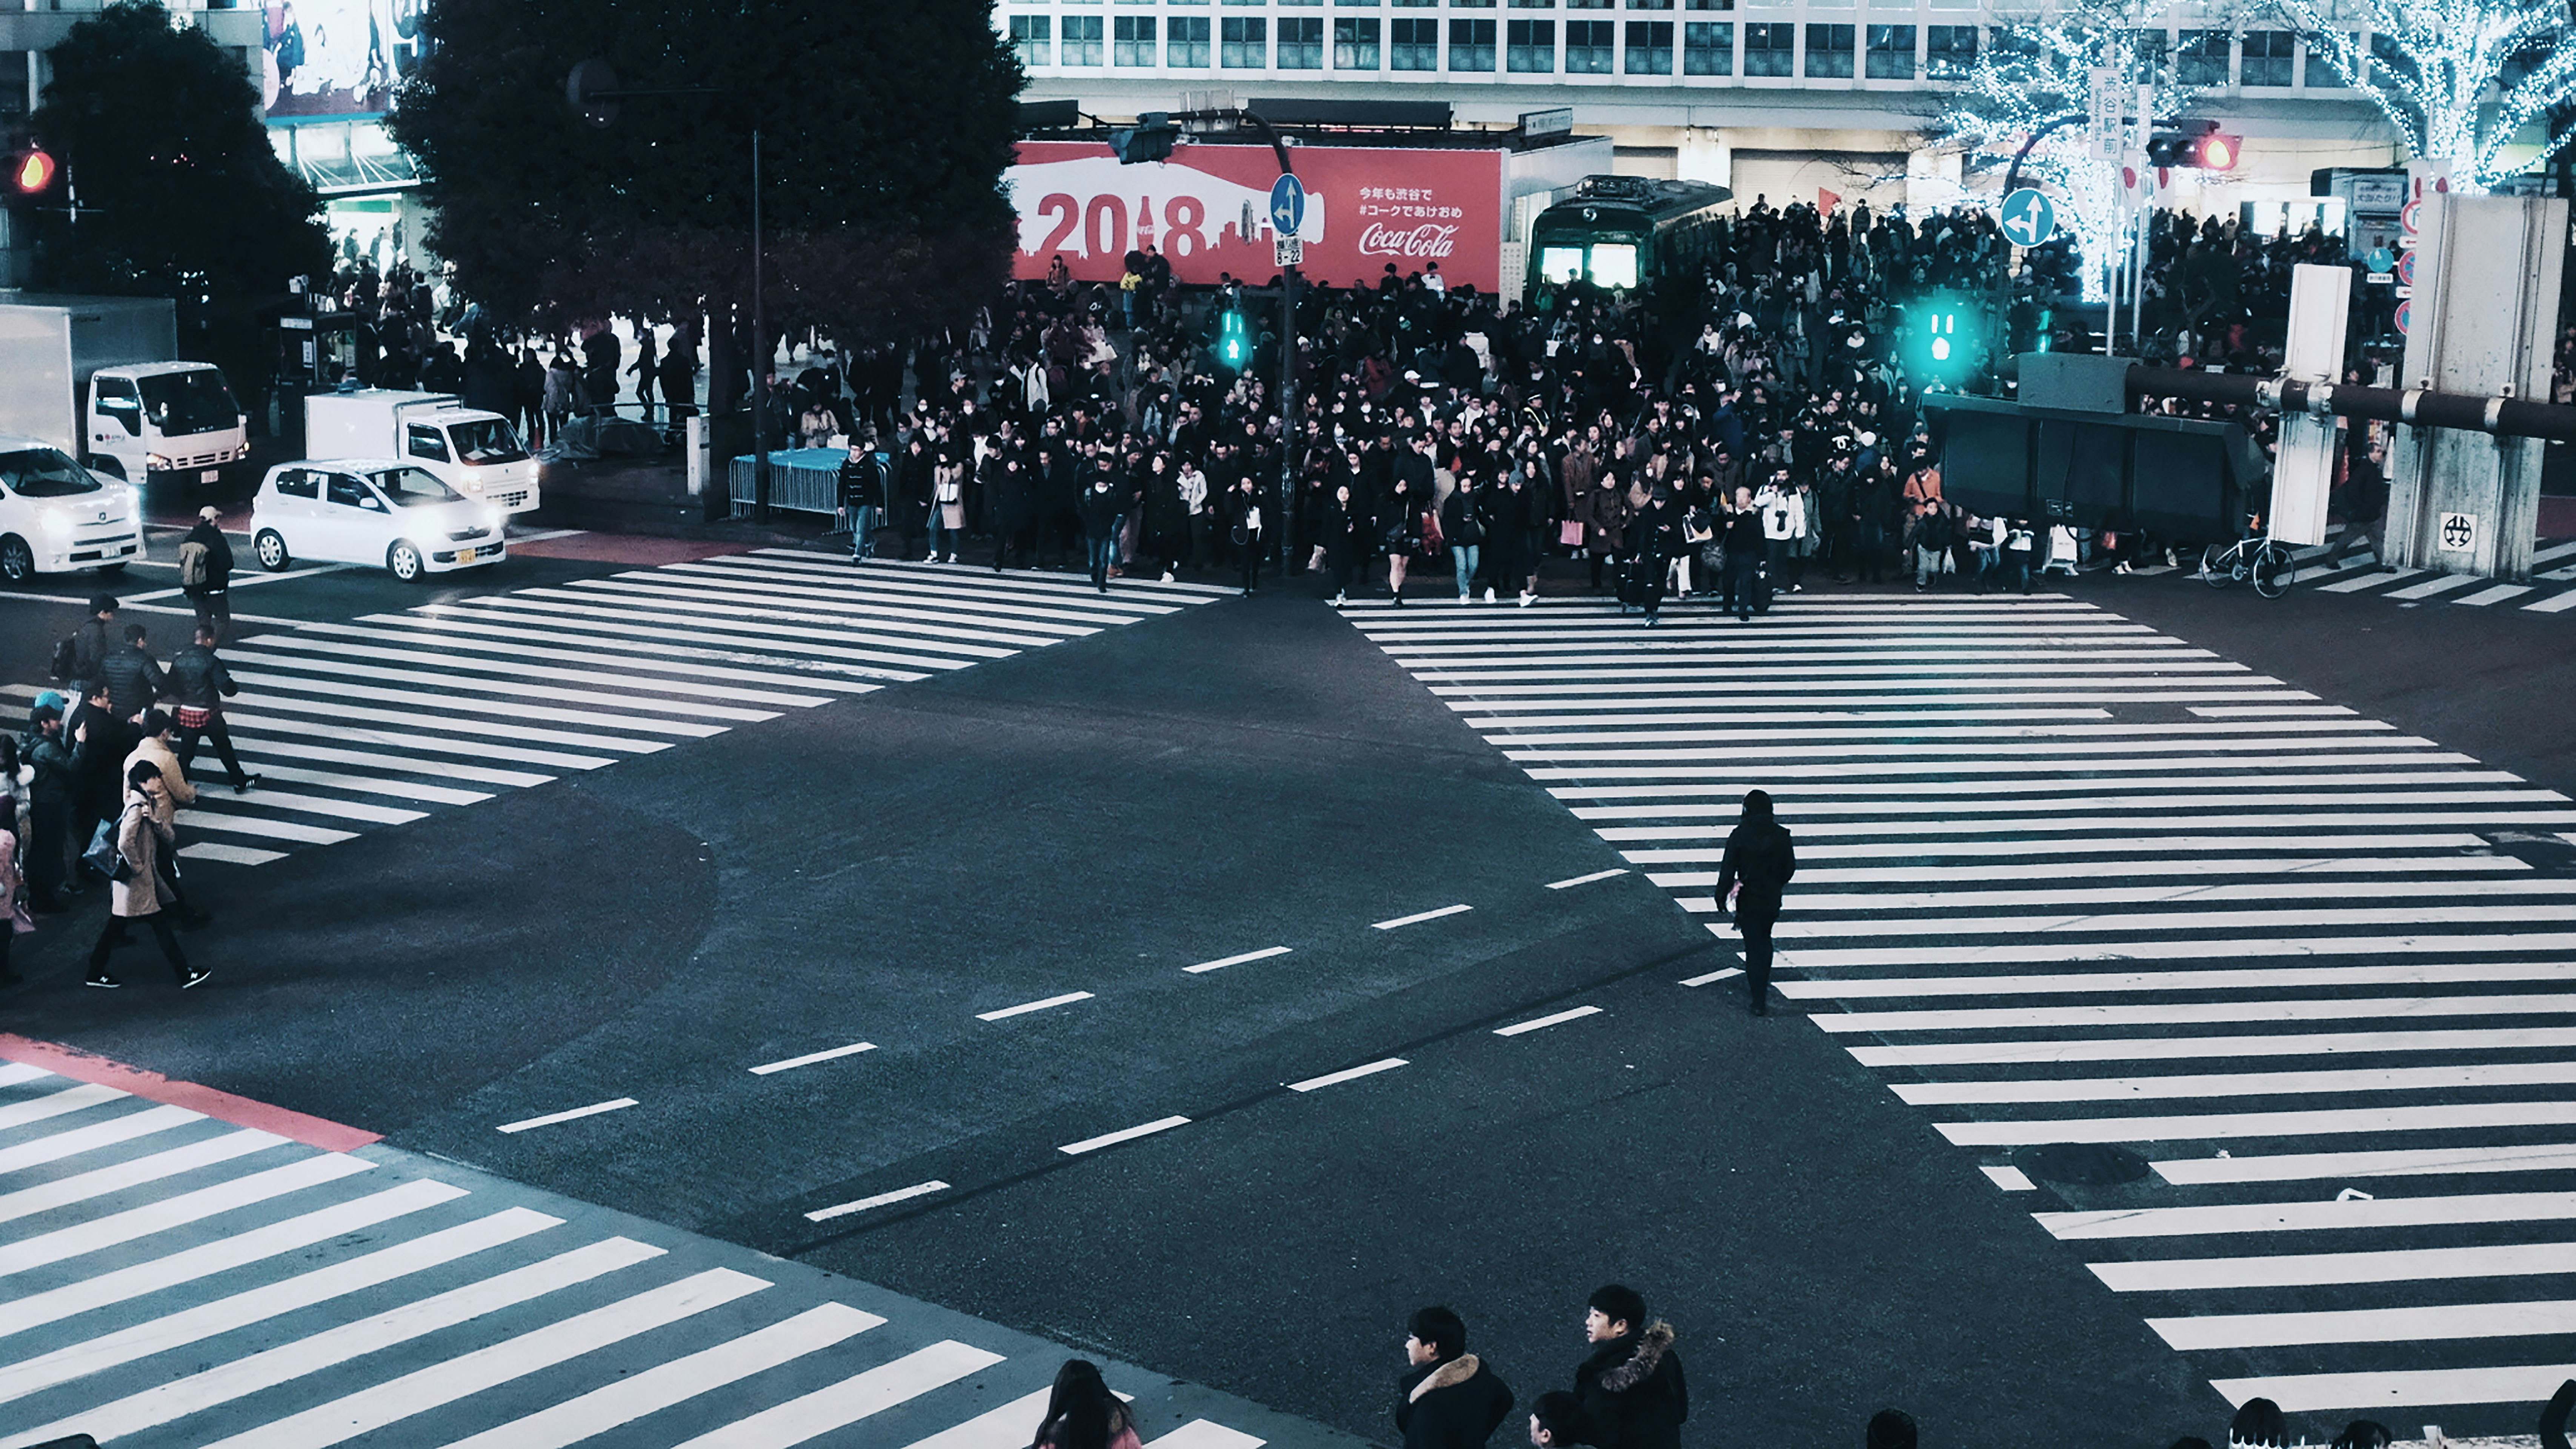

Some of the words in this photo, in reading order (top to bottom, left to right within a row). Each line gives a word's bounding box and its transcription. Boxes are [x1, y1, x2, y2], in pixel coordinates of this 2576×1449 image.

[2104, 77, 2118, 154] 渋谷駅前
[1359, 205, 1463, 218] #コークであけおめ
[1360, 187, 1432, 201] 今年も渋谷で
[1038, 193, 1207, 257] 2018
[1358, 222, 1459, 257] Coca-Cola
